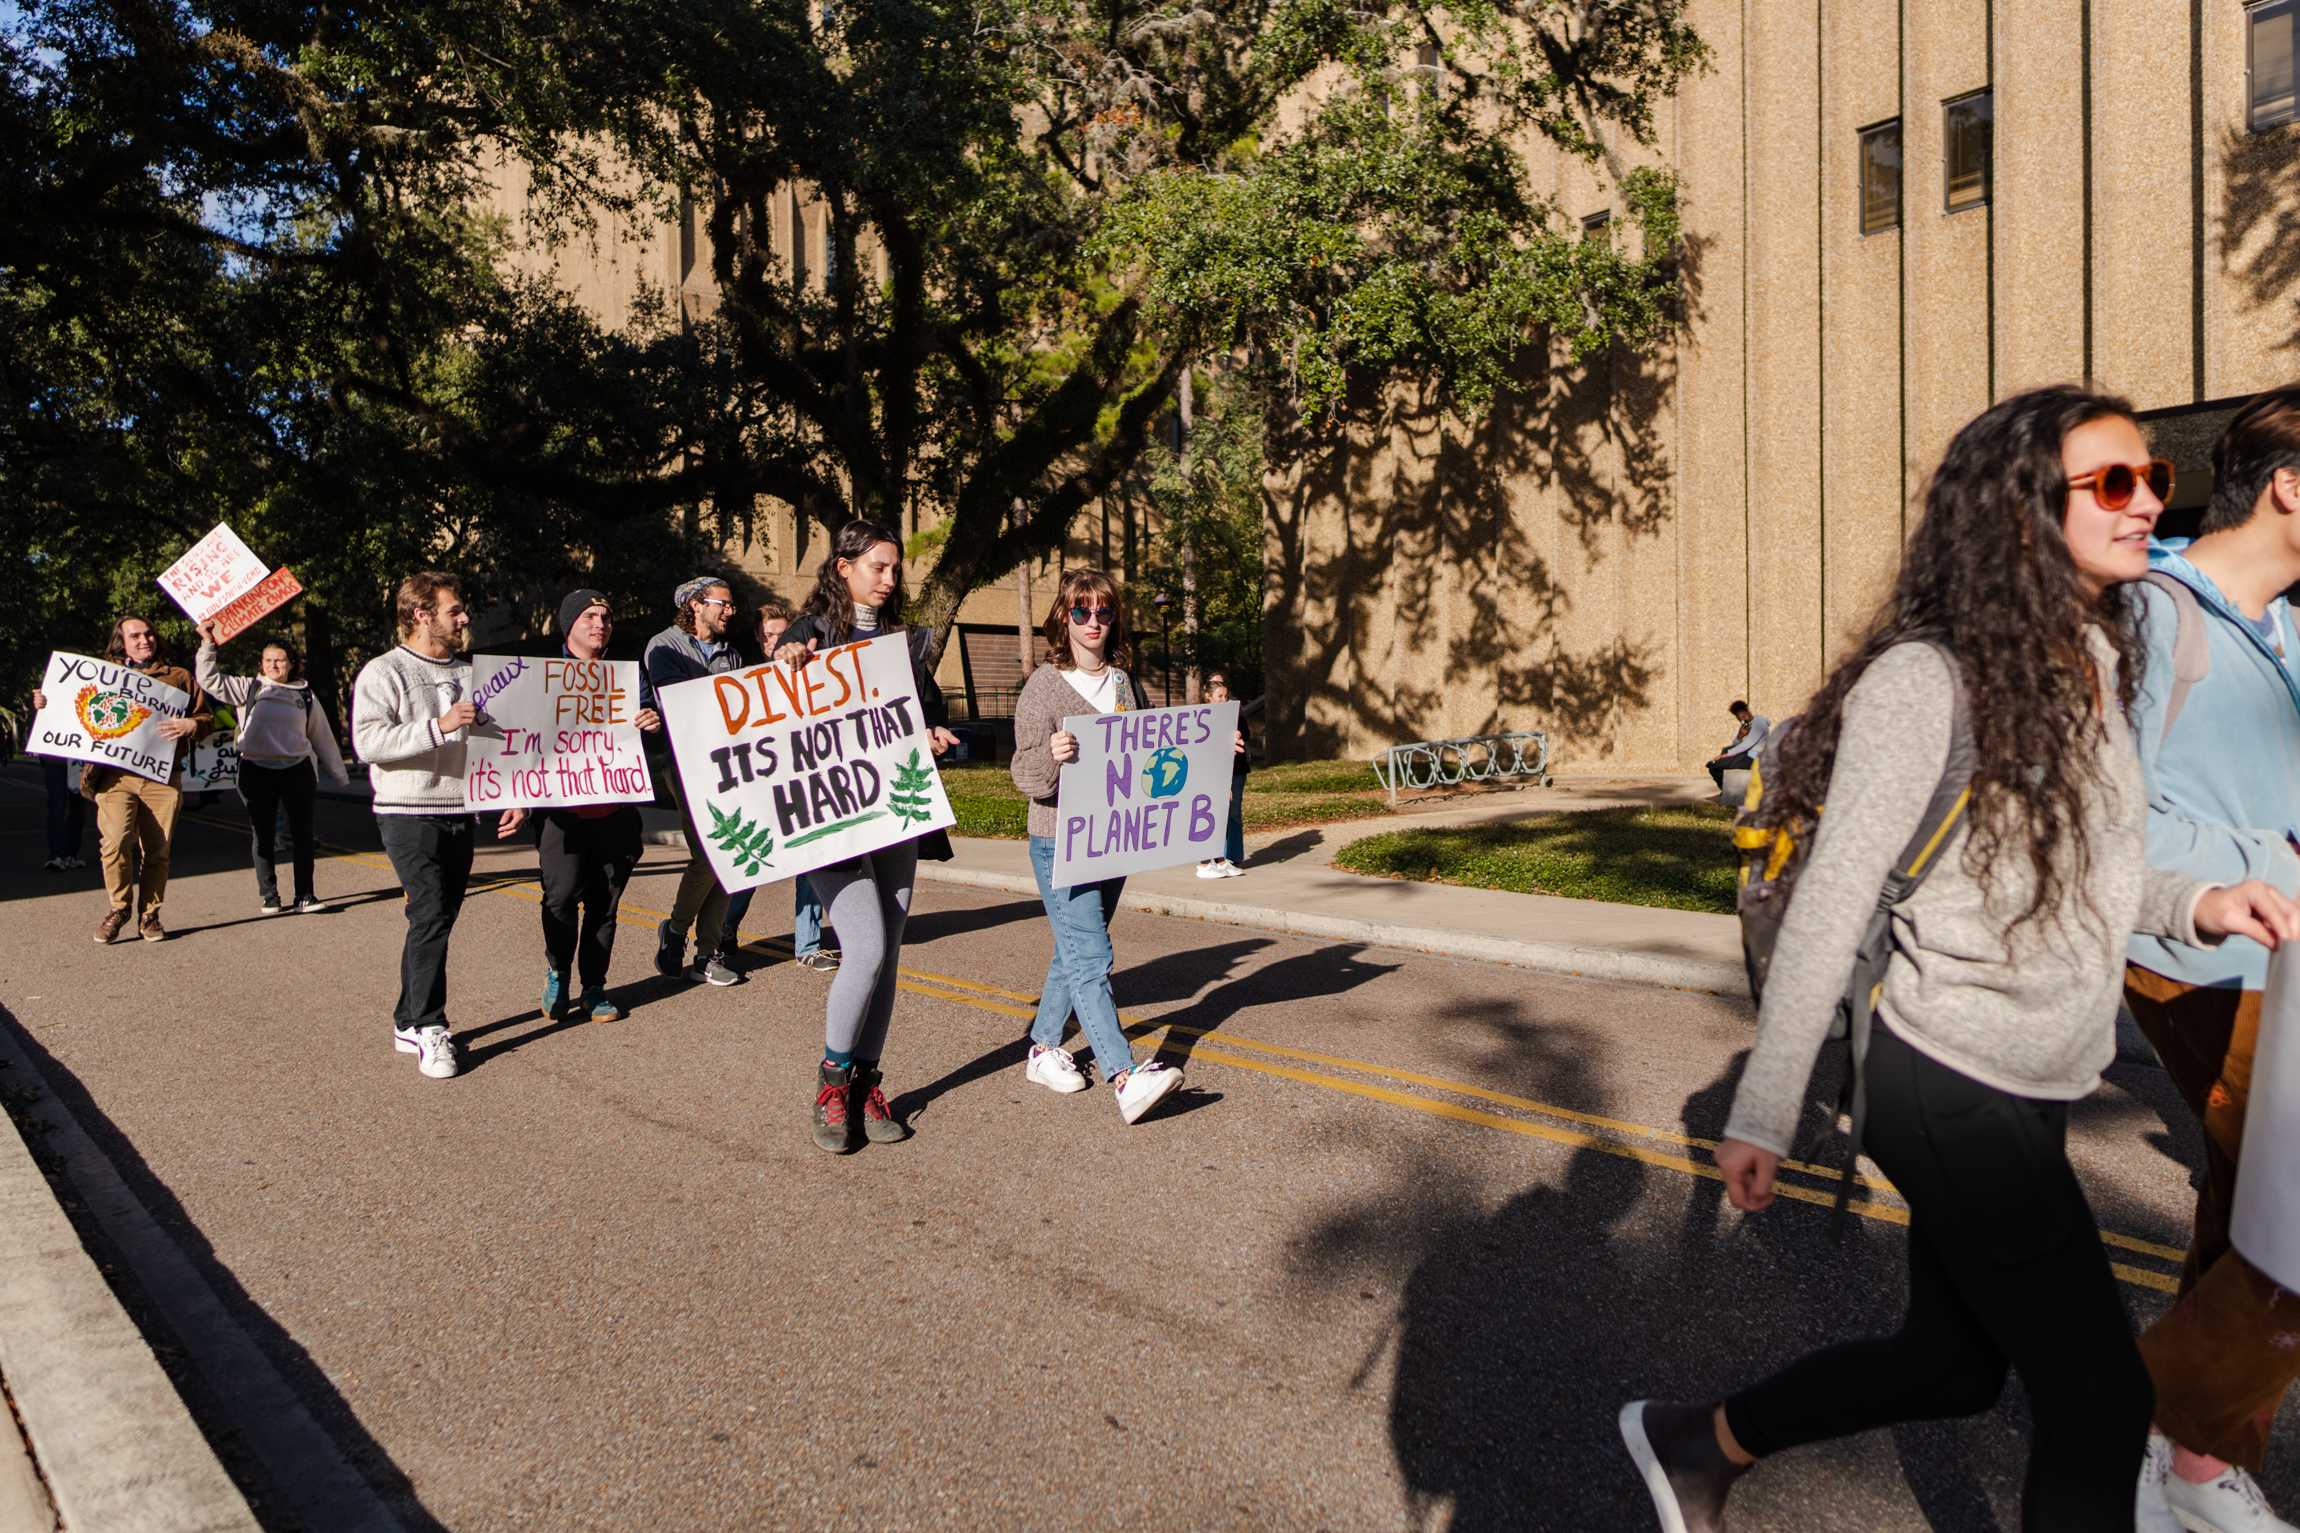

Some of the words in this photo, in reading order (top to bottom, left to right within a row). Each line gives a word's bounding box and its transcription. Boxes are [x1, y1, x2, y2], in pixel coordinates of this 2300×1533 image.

[171, 542, 228, 592] RISING
[200, 570, 232, 598] WE
[215, 584, 268, 625] BANKING
[220, 602, 266, 638] CLIMATE
[266, 580, 299, 606] CHAOS
[544, 660, 625, 694] FOSSIL
[714, 639, 879, 736] DIVEST.
[556, 694, 627, 726] FREE
[1095, 708, 1211, 753] THERE'S
[43, 730, 82, 748] OUR
[90, 740, 170, 780] FUTURE
[500, 728, 542, 756] I'm
[710, 736, 778, 793] ITS
[790, 718, 843, 772] NOT
[845, 695, 914, 754] THAT
[469, 757, 501, 802] it's
[512, 757, 552, 800] not
[556, 757, 598, 797] that
[772, 759, 881, 836] HARD
[1065, 801, 1180, 862] PLANET
[1188, 794, 1216, 842] B
